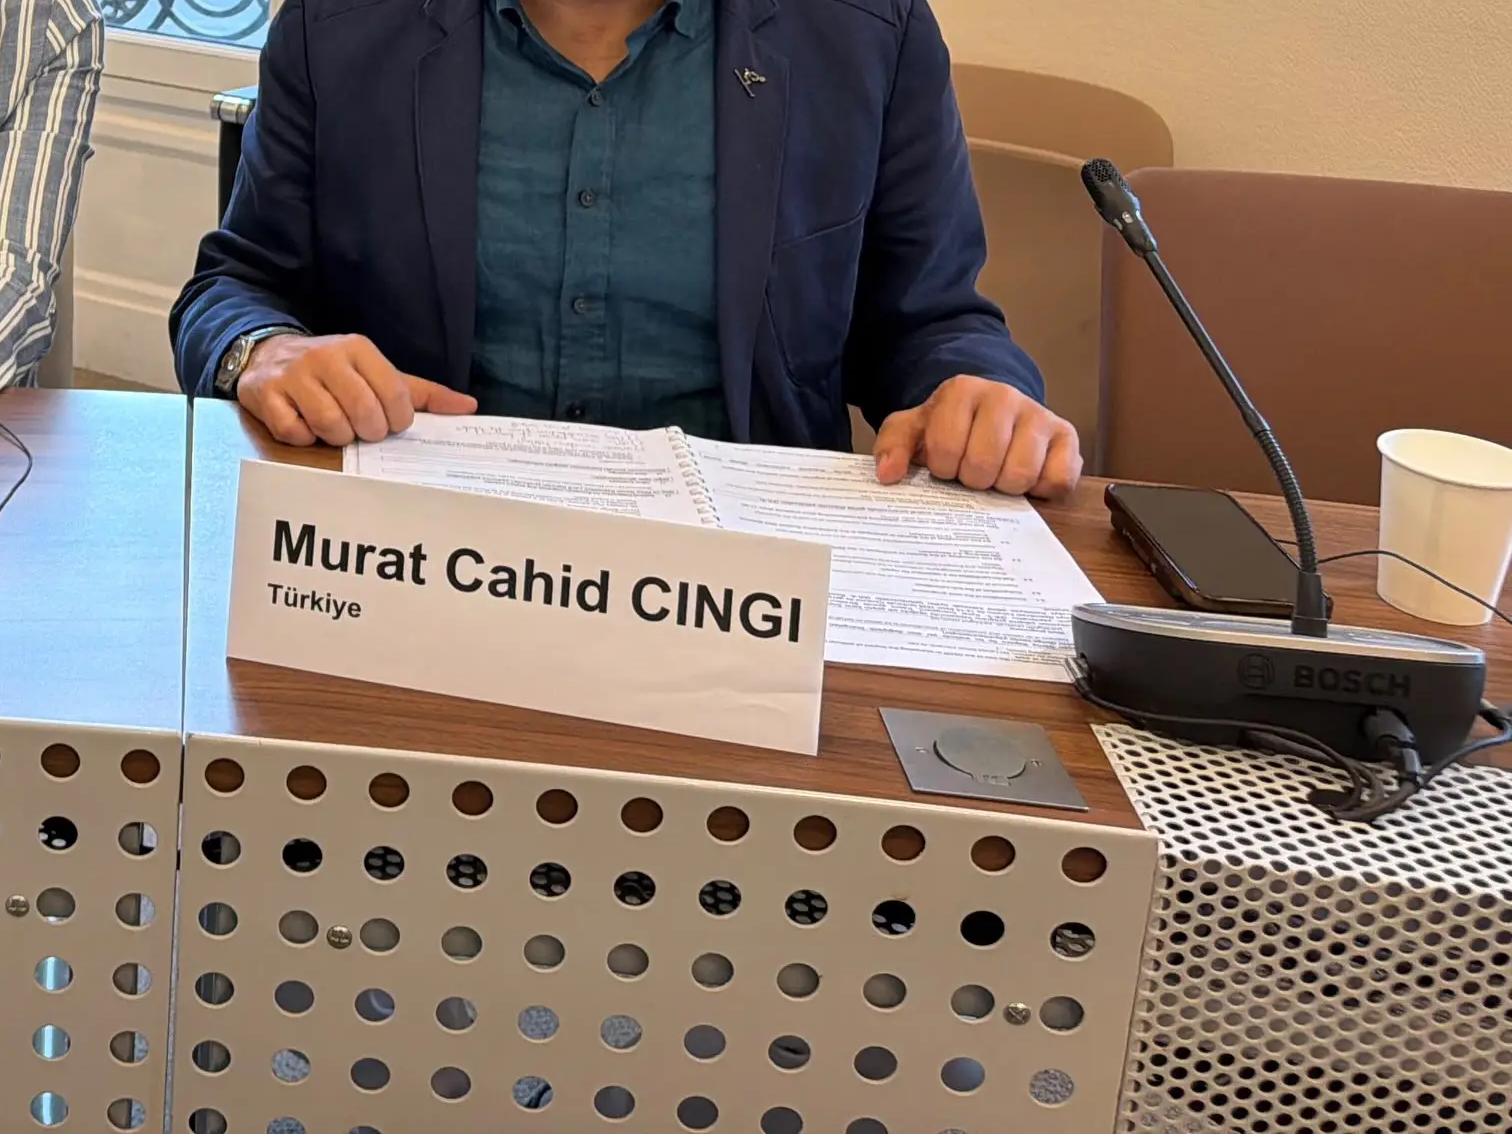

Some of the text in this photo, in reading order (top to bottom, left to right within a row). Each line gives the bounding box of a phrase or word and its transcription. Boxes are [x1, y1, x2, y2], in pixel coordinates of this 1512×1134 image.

[272, 518, 429, 587] Murat
[445, 547, 611, 615] Cahid
[630, 575, 803, 644] CINGI
[266, 582, 363, 621] Türkiye
[1292, 665, 1412, 698] BOSCH
